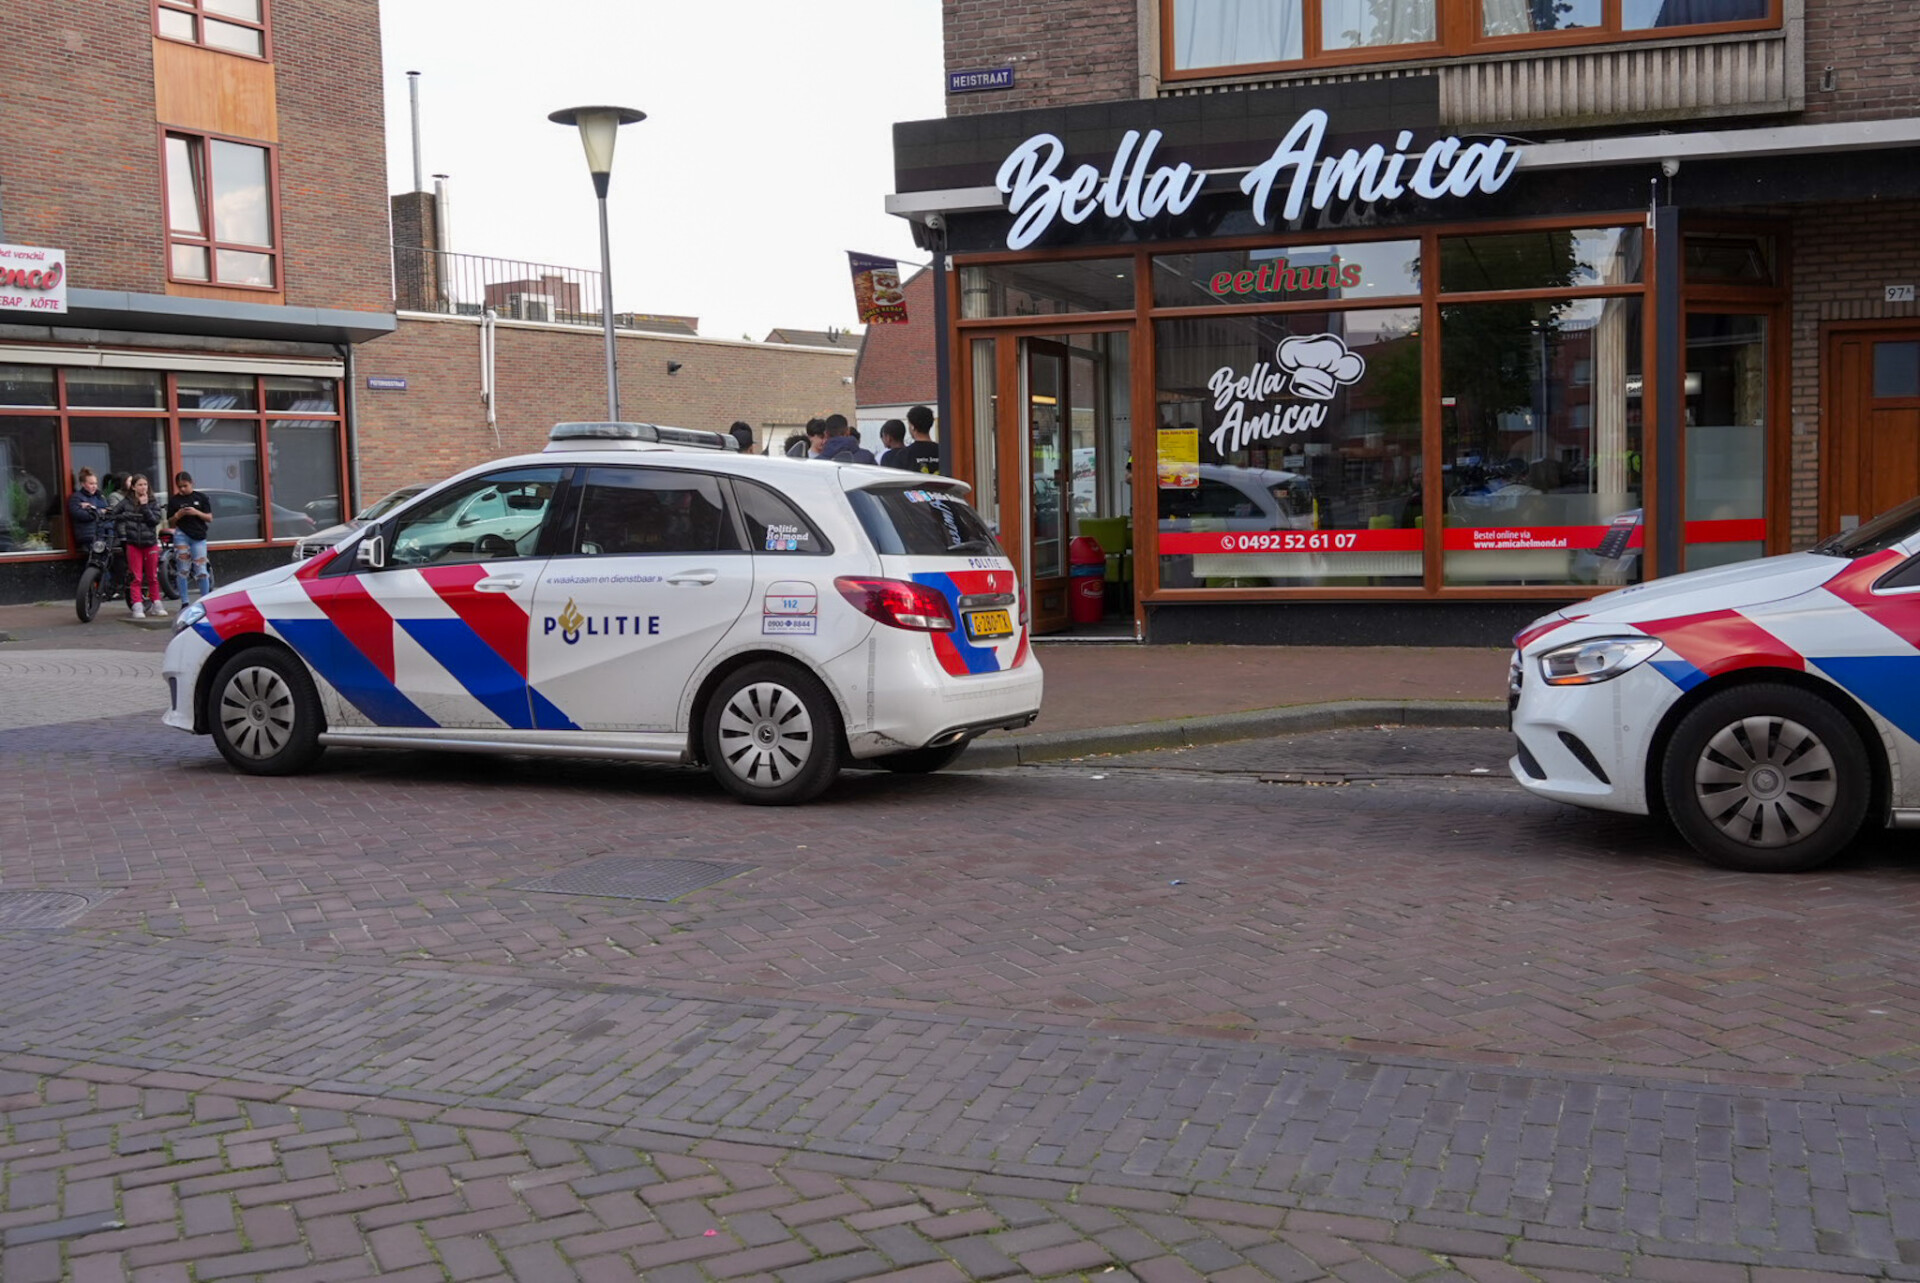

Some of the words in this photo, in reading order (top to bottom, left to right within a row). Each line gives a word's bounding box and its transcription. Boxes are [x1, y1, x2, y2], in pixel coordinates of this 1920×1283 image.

[953, 71, 1009, 88] HEISTRAAT
[995, 129, 1207, 251] Bella
[1240, 108, 1523, 227] Amica
[1209, 254, 1362, 295] eethuis
[31, 296, 59, 310] KÖFTE
[1207, 362, 1287, 411] Bella
[1208, 400, 1329, 457] Amica
[767, 524, 798, 533] Politie
[1473, 530, 1496, 540] Bestel
[1496, 530, 1519, 539] online
[1520, 529, 1532, 539] via
[766, 532, 809, 541] Helmond
[1238, 534, 1281, 549] 0492
[1284, 534, 1306, 549] 52
[1308, 533, 1329, 548] 61
[1334, 533, 1357, 548] 07
[1473, 538, 1567, 549] www.amicahelmond.nl
[968, 558, 1002, 569] POLITIE
[553, 576, 598, 584] waakzaam
[610, 574, 656, 583] dienstbaar
[783, 599, 799, 608] 112
[544, 616, 660, 645] POLITIE
